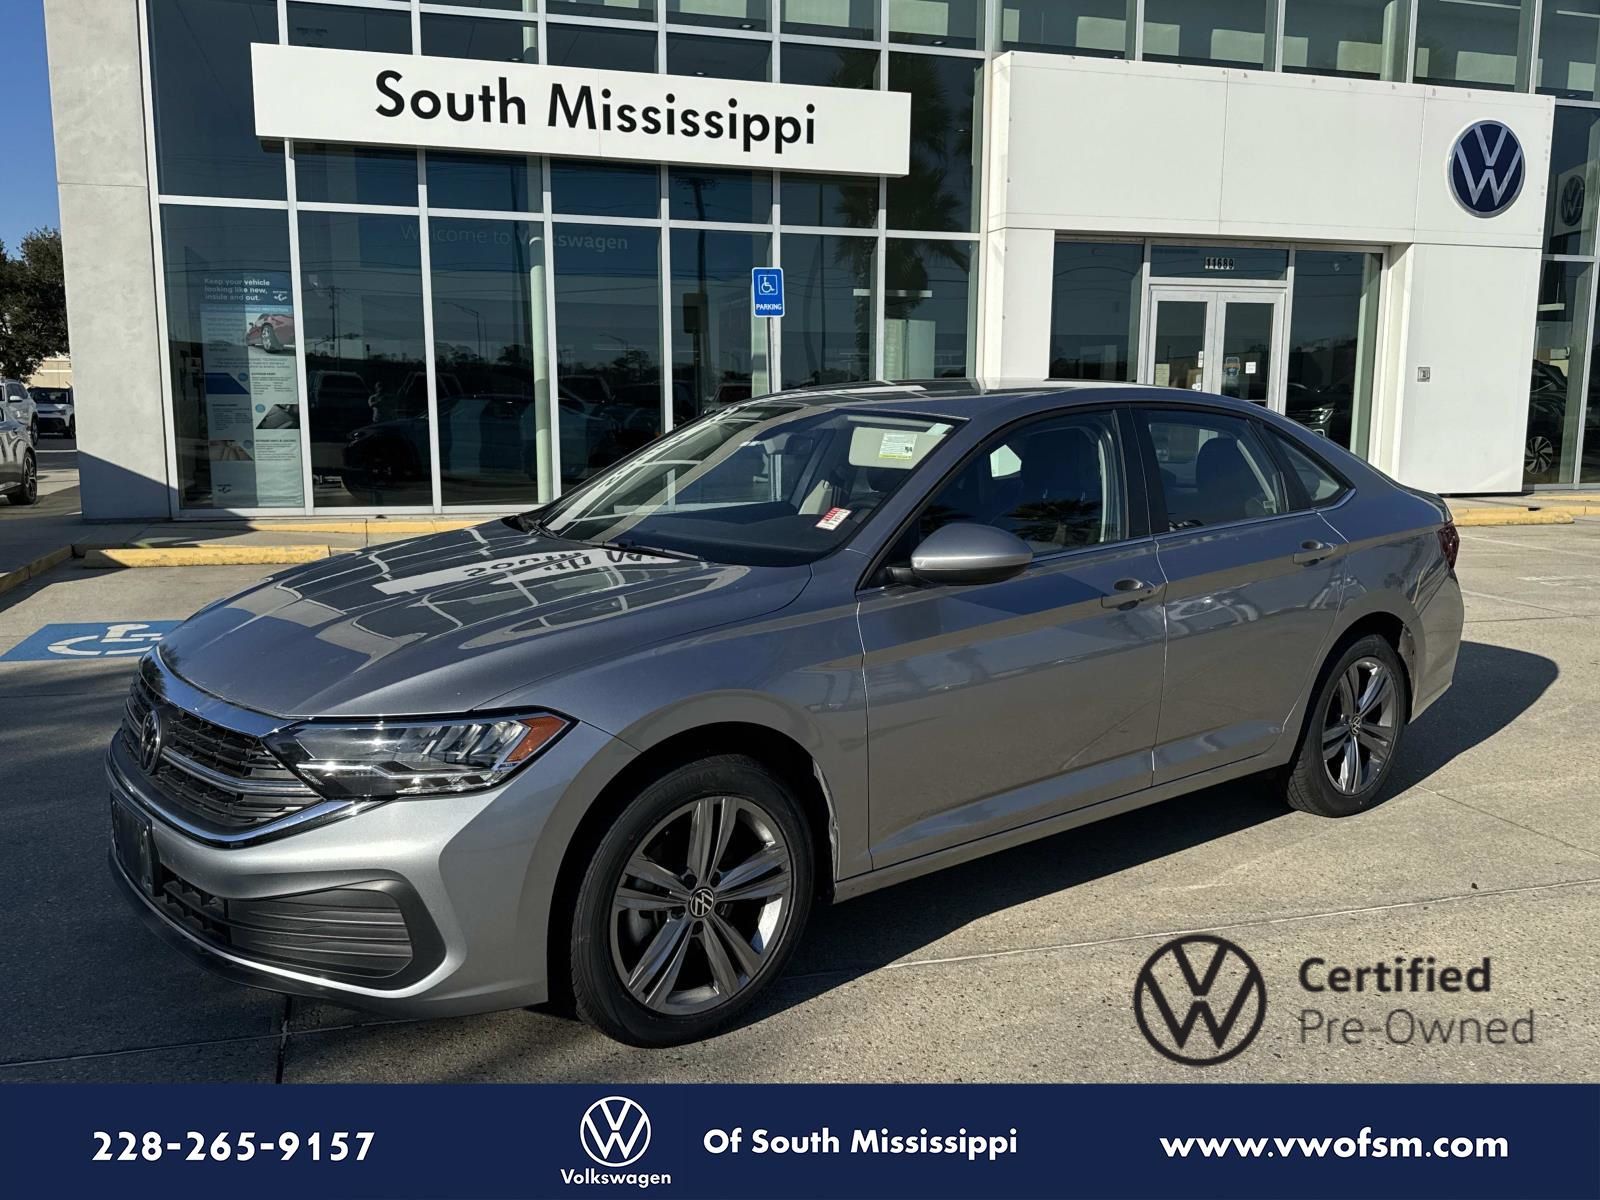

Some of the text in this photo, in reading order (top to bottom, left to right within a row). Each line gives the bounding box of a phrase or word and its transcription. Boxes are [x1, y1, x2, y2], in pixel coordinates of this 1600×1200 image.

[375, 70, 816, 154] South Mississippi
[1448, 120, 1525, 218] VW
[493, 231, 510, 246] to
[756, 303, 782, 311] PARKING
